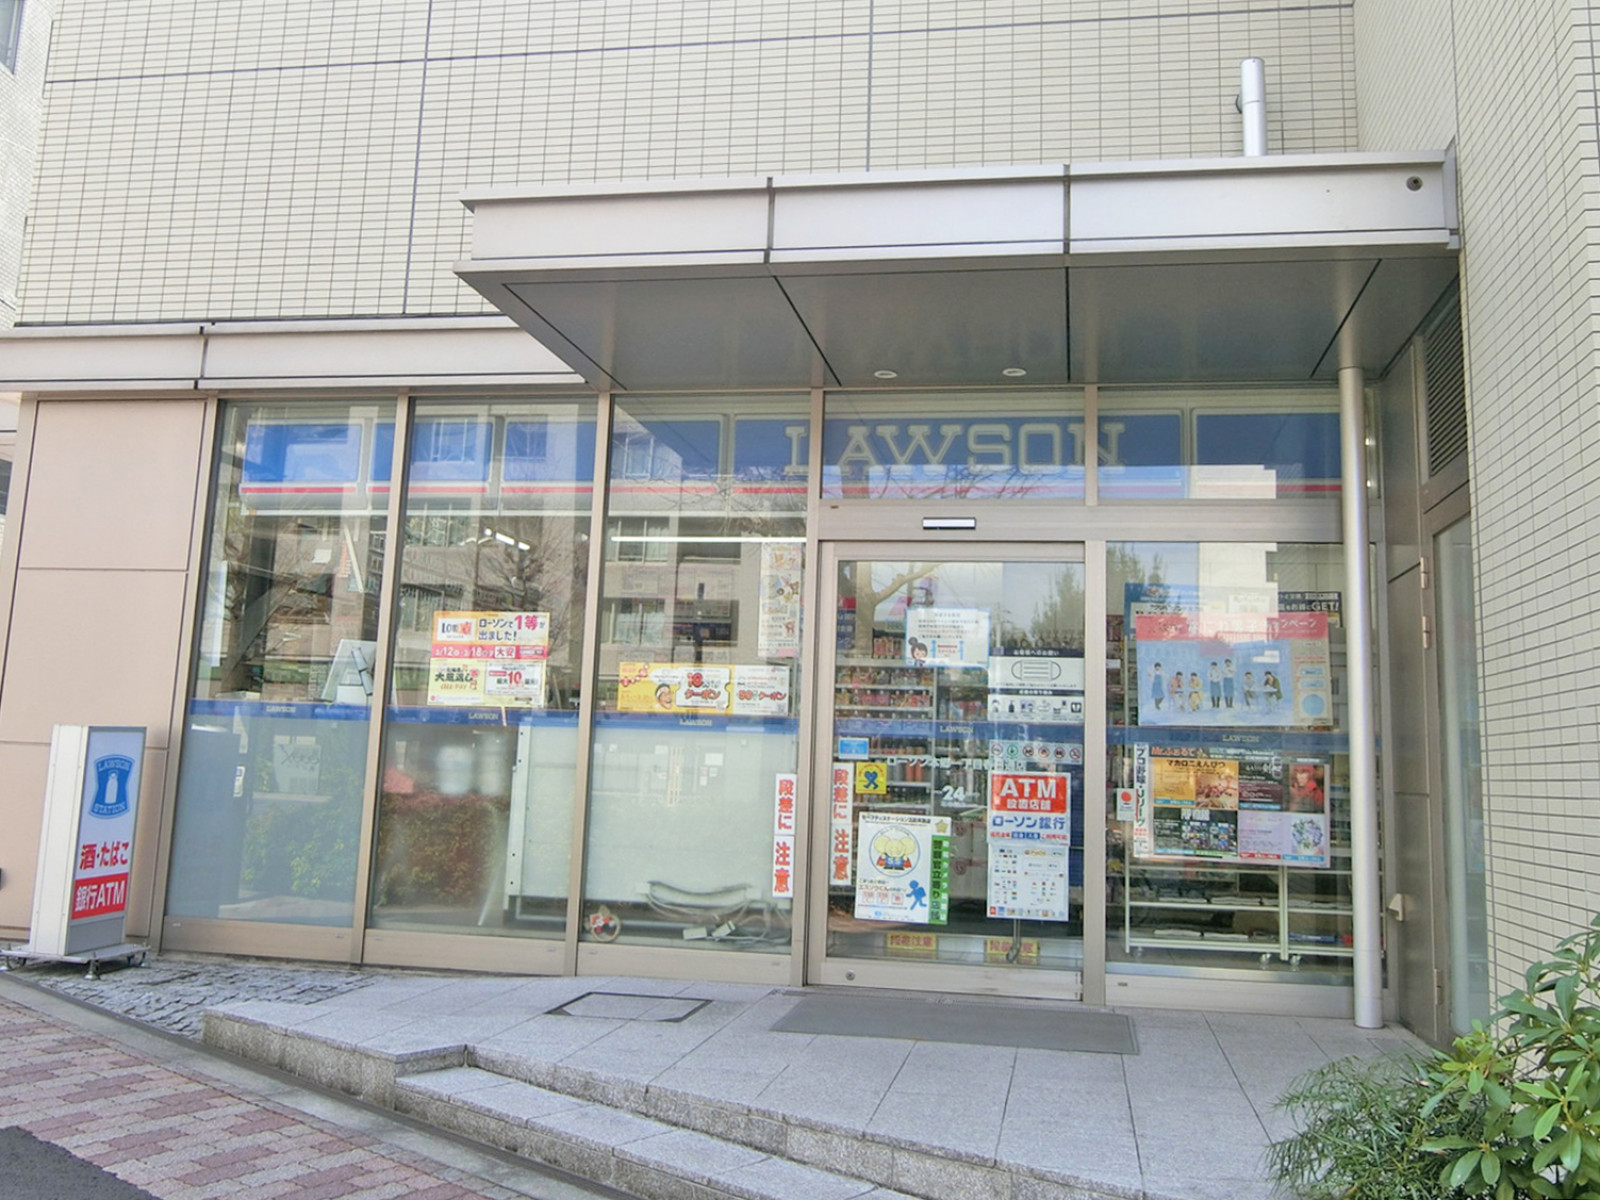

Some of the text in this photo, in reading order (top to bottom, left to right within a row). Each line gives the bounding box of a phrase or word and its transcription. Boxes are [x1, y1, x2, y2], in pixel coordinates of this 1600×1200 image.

[783, 422, 1126, 476] LAWSON
[941, 785, 966, 801] 24
[1000, 778, 1057, 799] ATM
[992, 815, 1066, 830] ローソン銀行
[79, 841, 130, 871] 酒・たばこ
[74, 883, 126, 913] 銀行ATM
